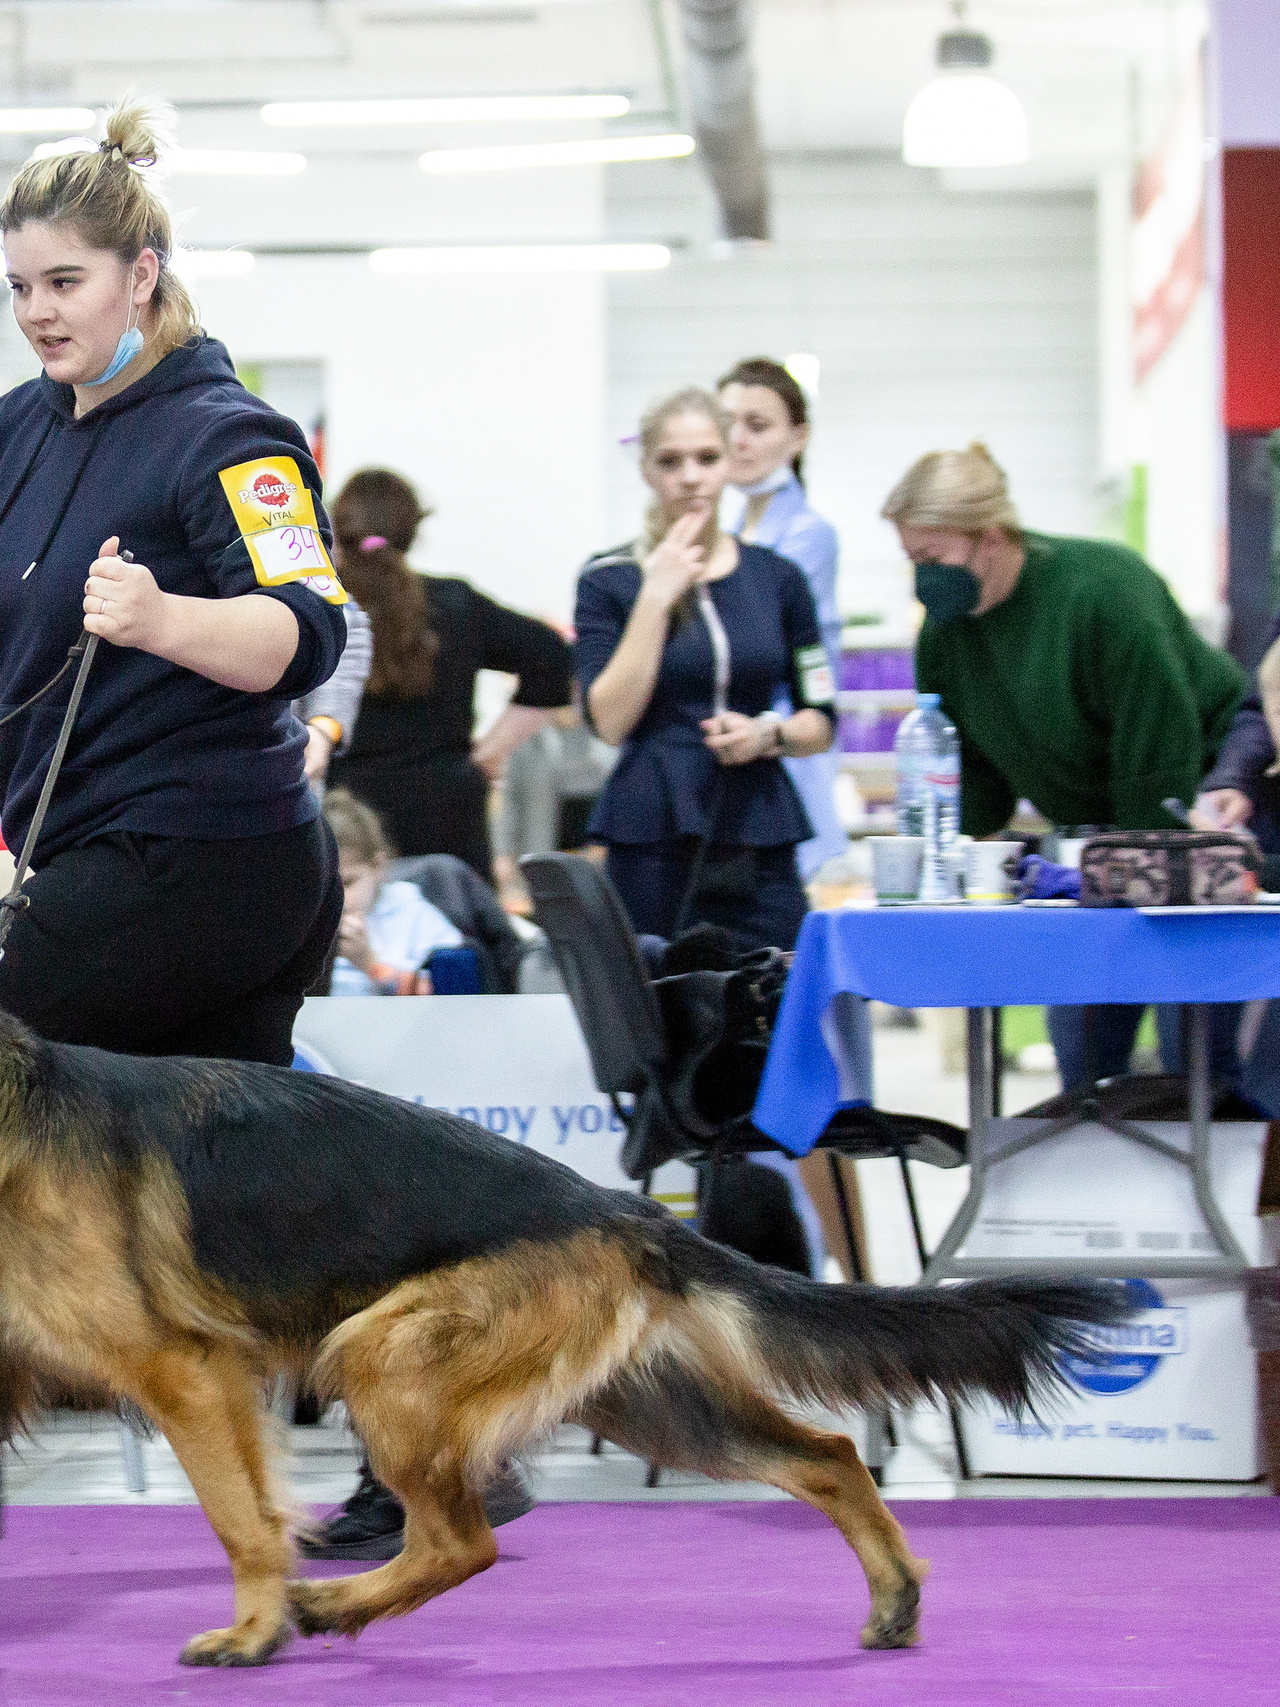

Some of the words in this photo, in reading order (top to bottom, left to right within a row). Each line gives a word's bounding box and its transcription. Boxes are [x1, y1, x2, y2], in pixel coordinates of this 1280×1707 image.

[237, 483, 297, 504] Pedigree
[262, 511, 295, 527] VITAL
[280, 527, 322, 566] 34
